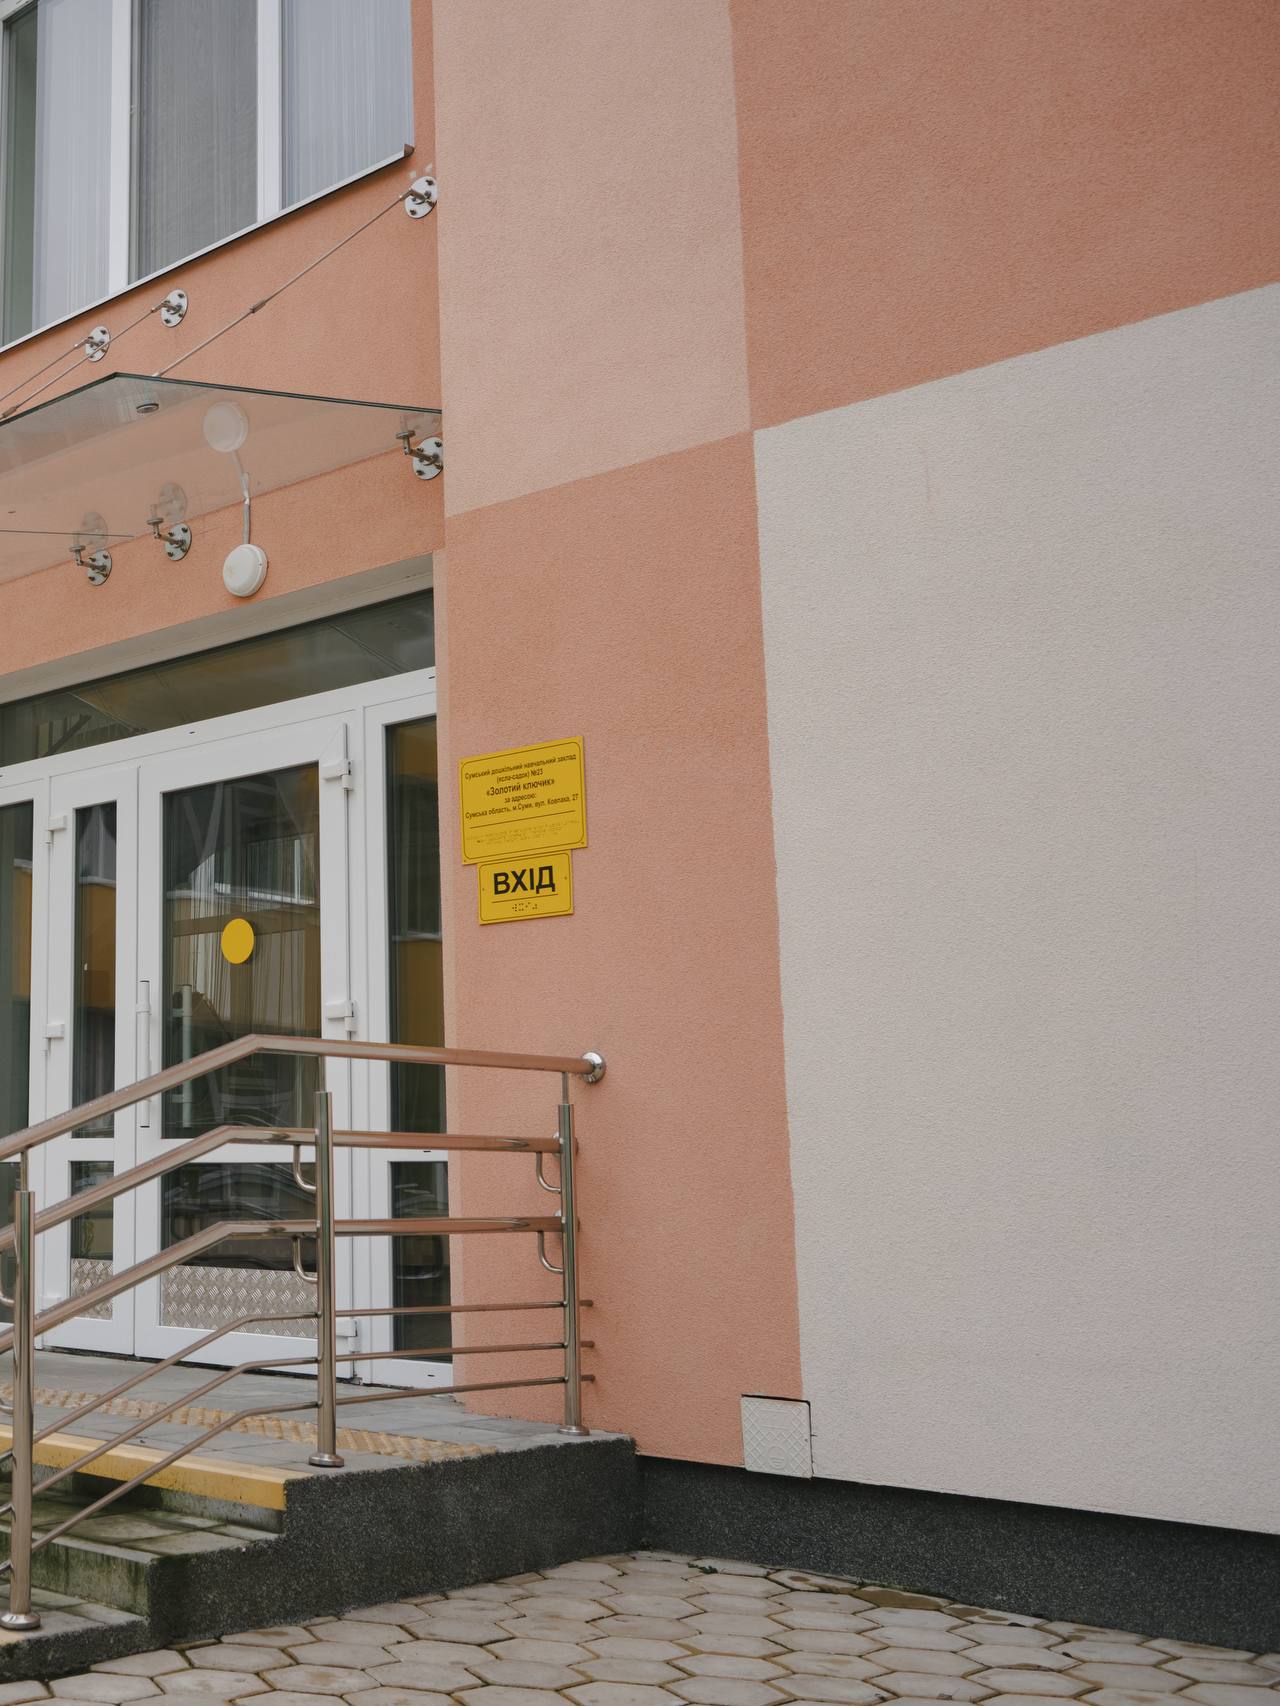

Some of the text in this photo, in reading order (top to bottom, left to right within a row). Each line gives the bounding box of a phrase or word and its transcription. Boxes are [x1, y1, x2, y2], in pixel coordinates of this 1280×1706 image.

[486, 777, 555, 796] «Золотий ключик»
[494, 865, 556, 895] ВХІД
